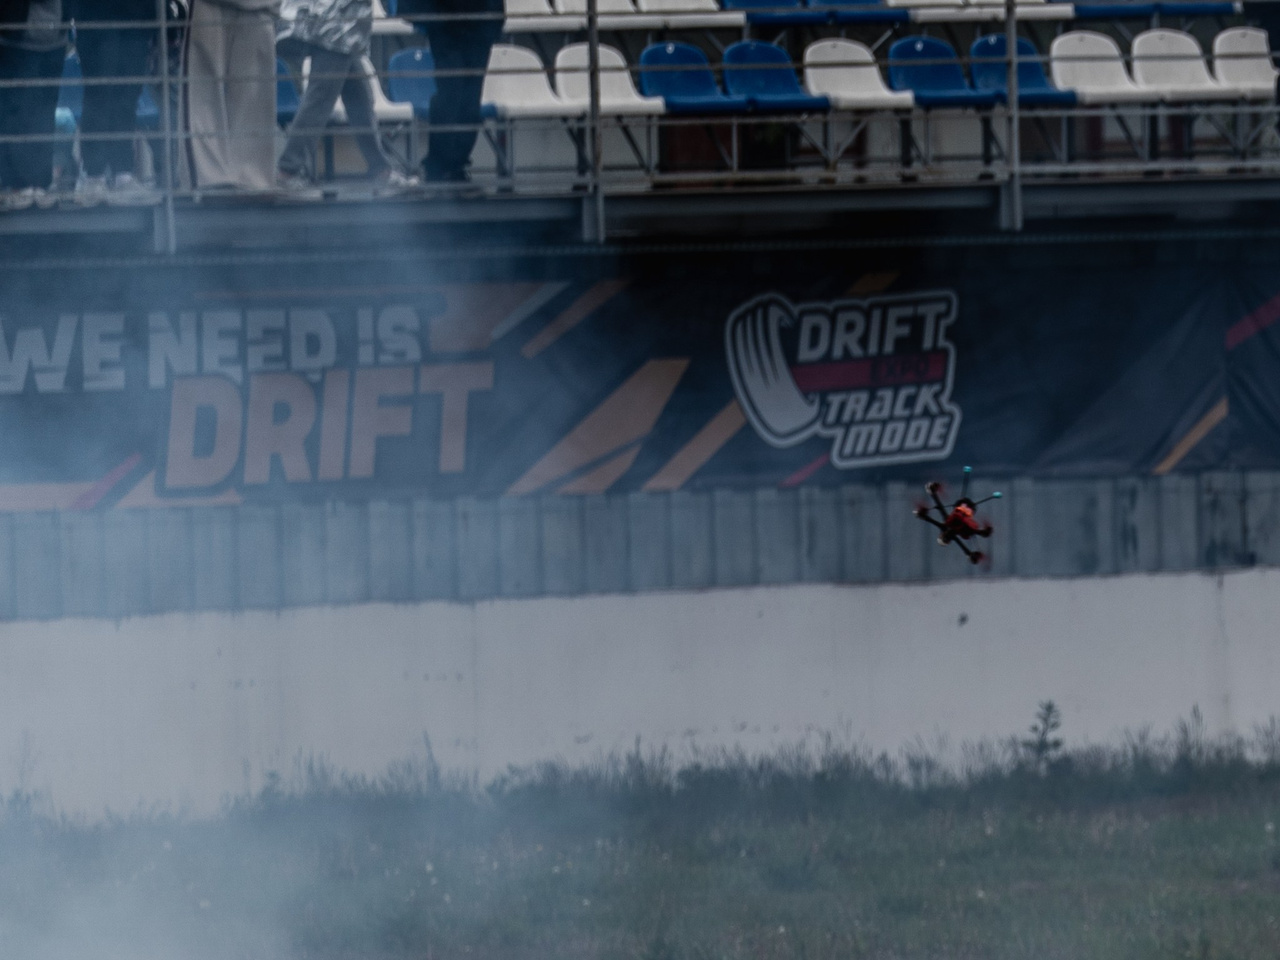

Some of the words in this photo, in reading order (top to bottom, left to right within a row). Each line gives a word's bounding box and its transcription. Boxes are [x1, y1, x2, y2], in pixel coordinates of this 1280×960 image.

[0, 312, 126, 394] WE
[148, 306, 337, 388] NEED
[357, 304, 422, 366] IS
[797, 301, 949, 363] DRIFT
[164, 360, 495, 490] DRIFT
[825, 383, 943, 425] TRACK
[842, 415, 950, 457] MODE
